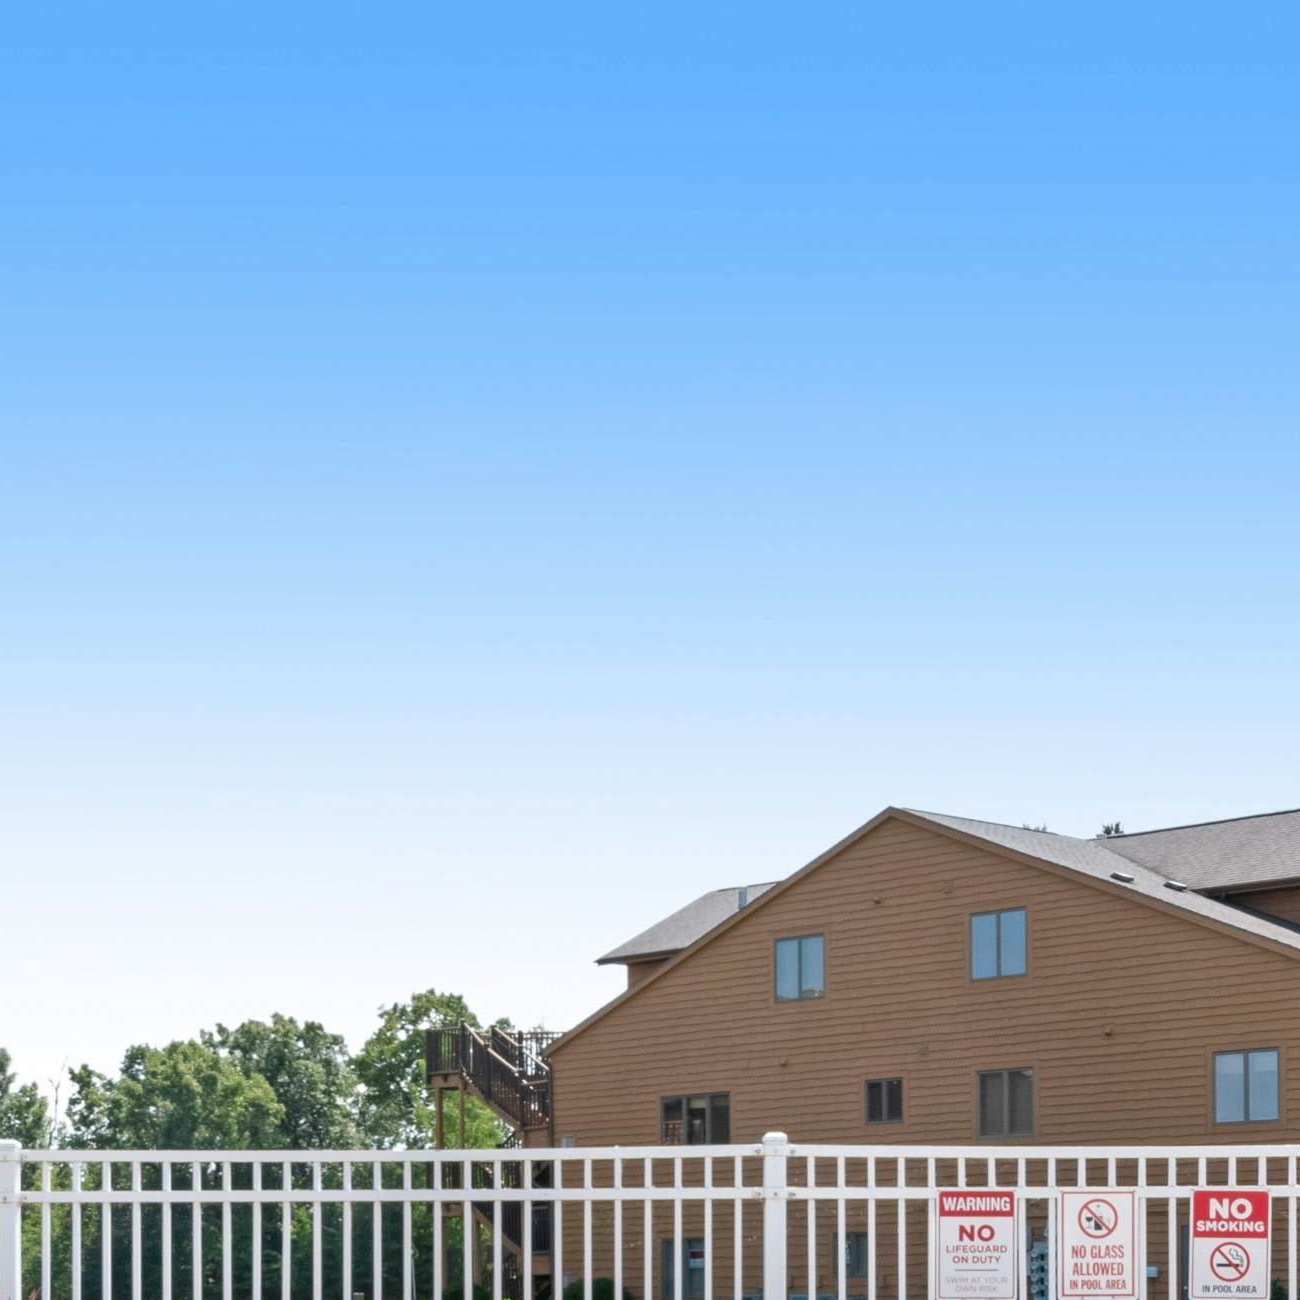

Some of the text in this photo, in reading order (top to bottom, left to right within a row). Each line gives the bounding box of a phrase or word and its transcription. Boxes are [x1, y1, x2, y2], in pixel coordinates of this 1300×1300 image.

[942, 1196, 1011, 1212] WARNING
[1209, 1198, 1253, 1219] NO
[958, 1224, 995, 1242] NO
[1196, 1220, 1265, 1233] SMOKING
[946, 1245, 1007, 1253] LIFEGUARD
[1071, 1245, 1125, 1259] NO GLASS
[952, 1255, 1001, 1264] ON DUTY
[1072, 1262, 1124, 1276] ALLOWED
[1070, 1279, 1126, 1289] IN POOL AREA
[1202, 1285, 1257, 1293] IN POOL AREA
